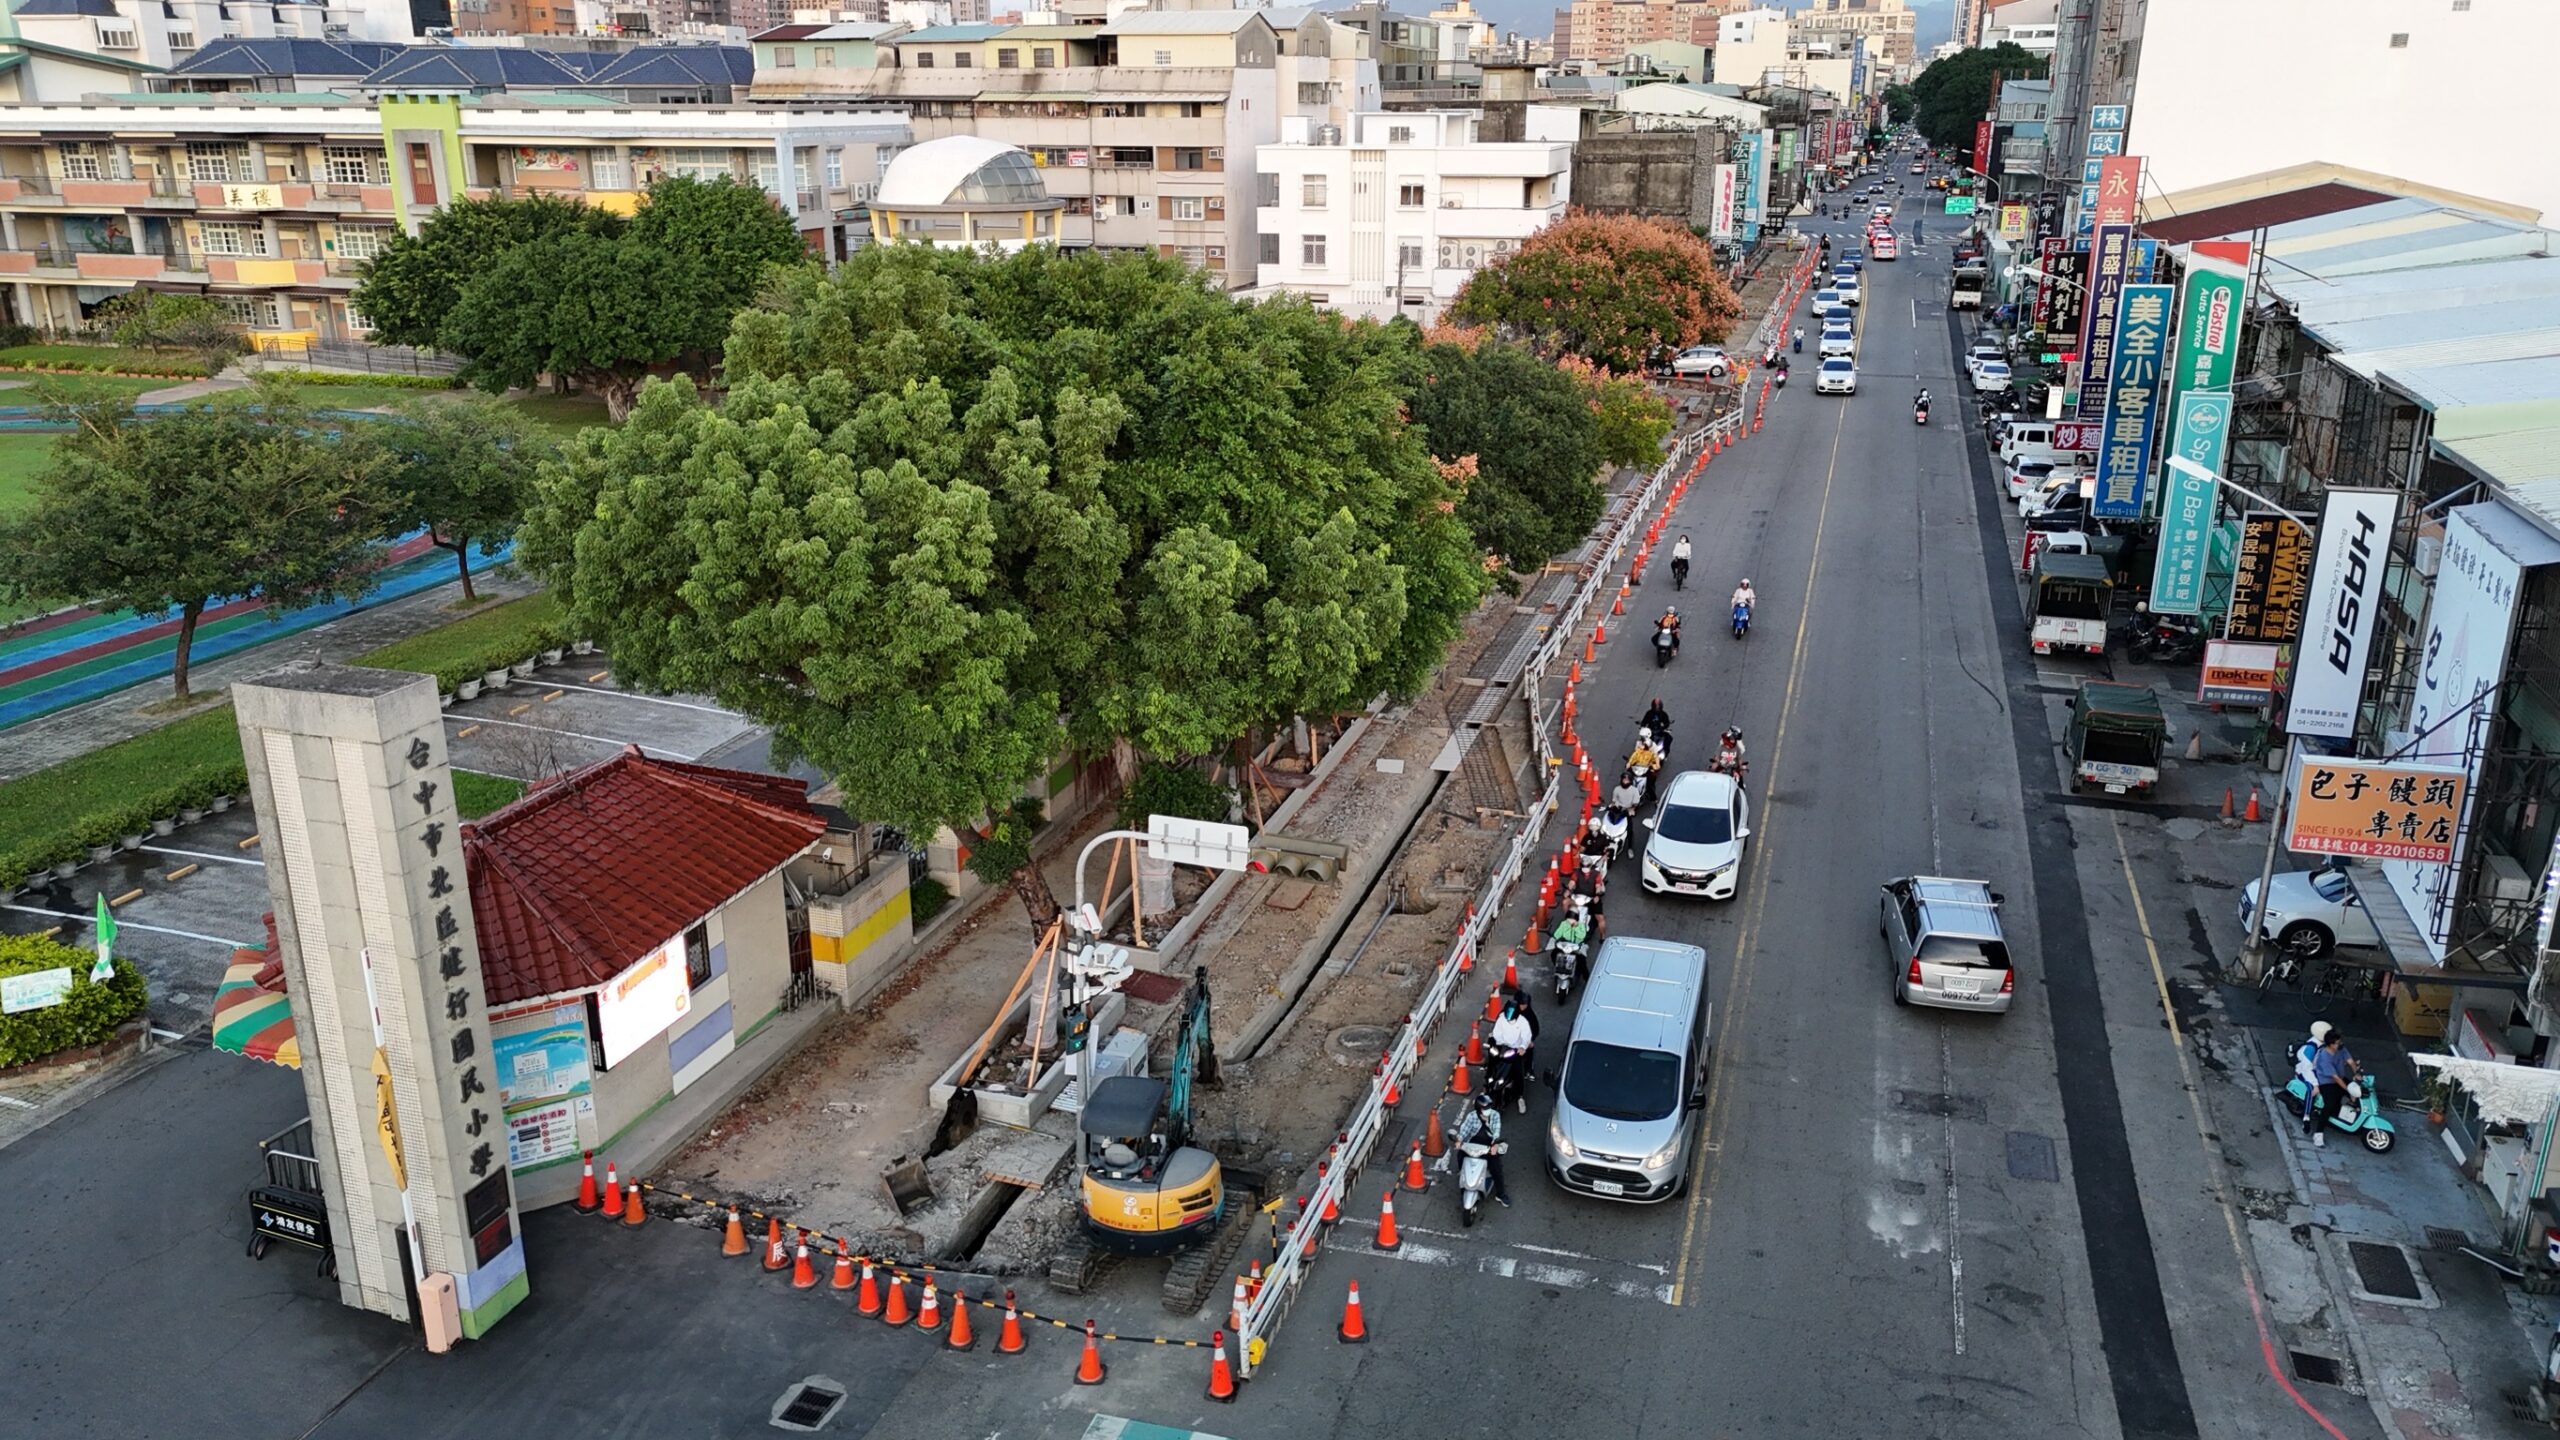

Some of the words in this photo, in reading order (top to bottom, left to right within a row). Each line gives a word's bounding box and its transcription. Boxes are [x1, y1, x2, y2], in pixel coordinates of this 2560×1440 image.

[2089, 233, 2123, 379] 富盛小貨車租賃
[2198, 288, 2210, 313] Auto
[2193, 314, 2206, 348] Service
[2208, 303, 2227, 353] Castrol
[2104, 294, 2162, 504] 美全小客車租賃
[2183, 438, 2211, 491] Spg
[2183, 496, 2202, 526] Bar
[2229, 521, 2262, 635] 安昱電動工具行
[2329, 509, 2376, 676] HASA
[2211, 669, 2269, 682] maktec
[2298, 824, 2328, 836] SINCE
[2332, 827, 2363, 838] 1994
[2365, 810, 2453, 844] 專賣店
[406, 736, 493, 1178] 台中市北區健行國民小學
[1942, 991, 1980, 1002] 0097-ZG
